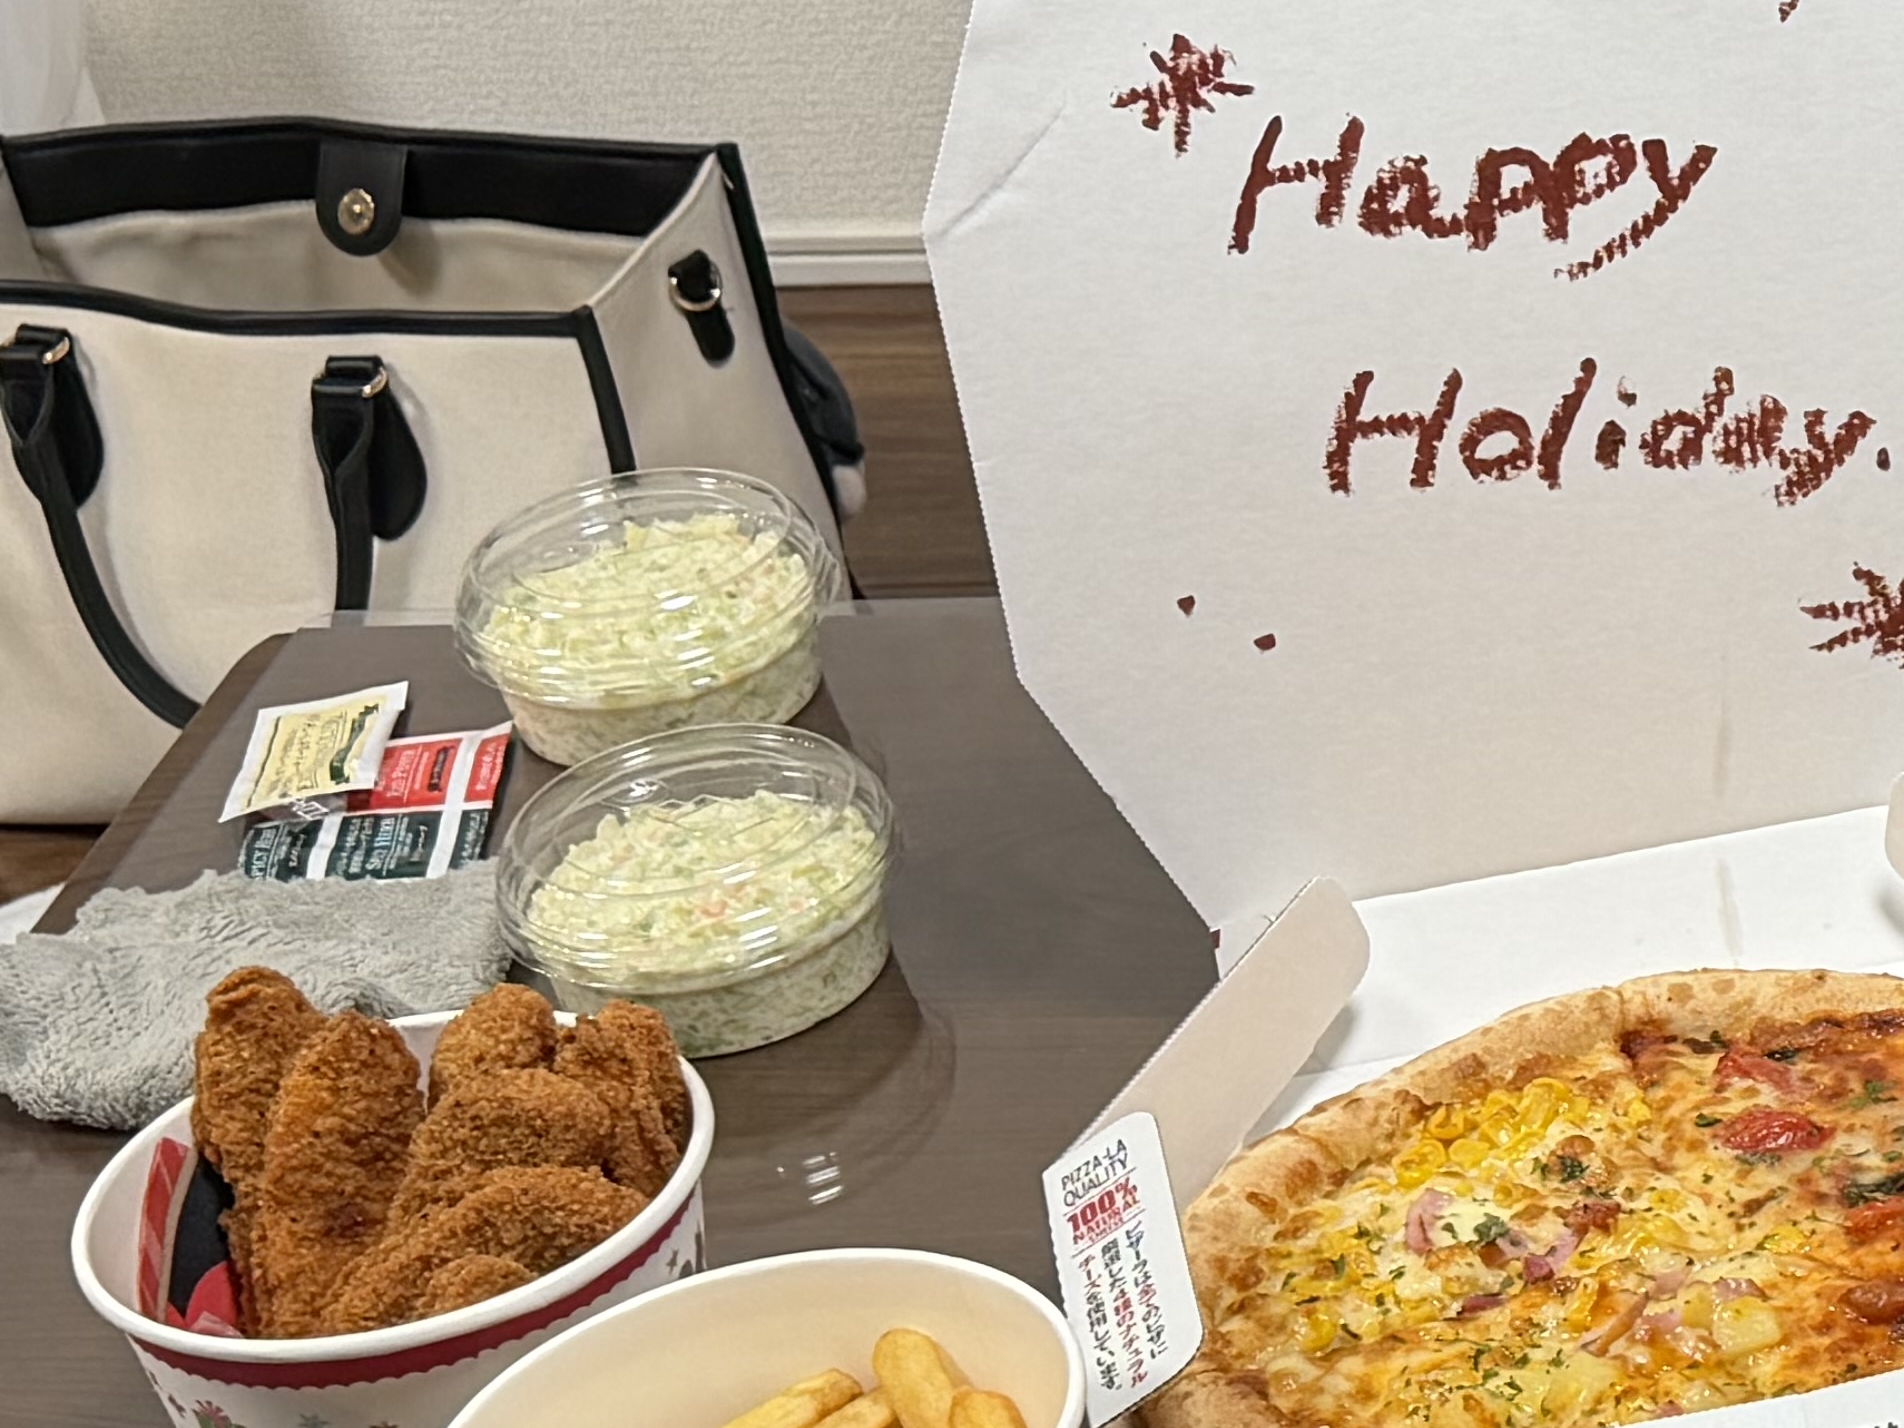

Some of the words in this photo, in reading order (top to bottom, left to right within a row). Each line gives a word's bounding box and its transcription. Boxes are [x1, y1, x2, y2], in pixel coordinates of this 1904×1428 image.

[1228, 114, 1716, 283] Happy
[1061, 1140, 1127, 1191] PIZZA-LA
[1063, 1155, 1130, 1208] QUALITY
[1066, 1178, 1139, 1234] 100%
[1078, 1254, 1124, 1392] チーズを使用しています。
[1125, 1225, 1168, 1359] ピザーラは全てのピザに
